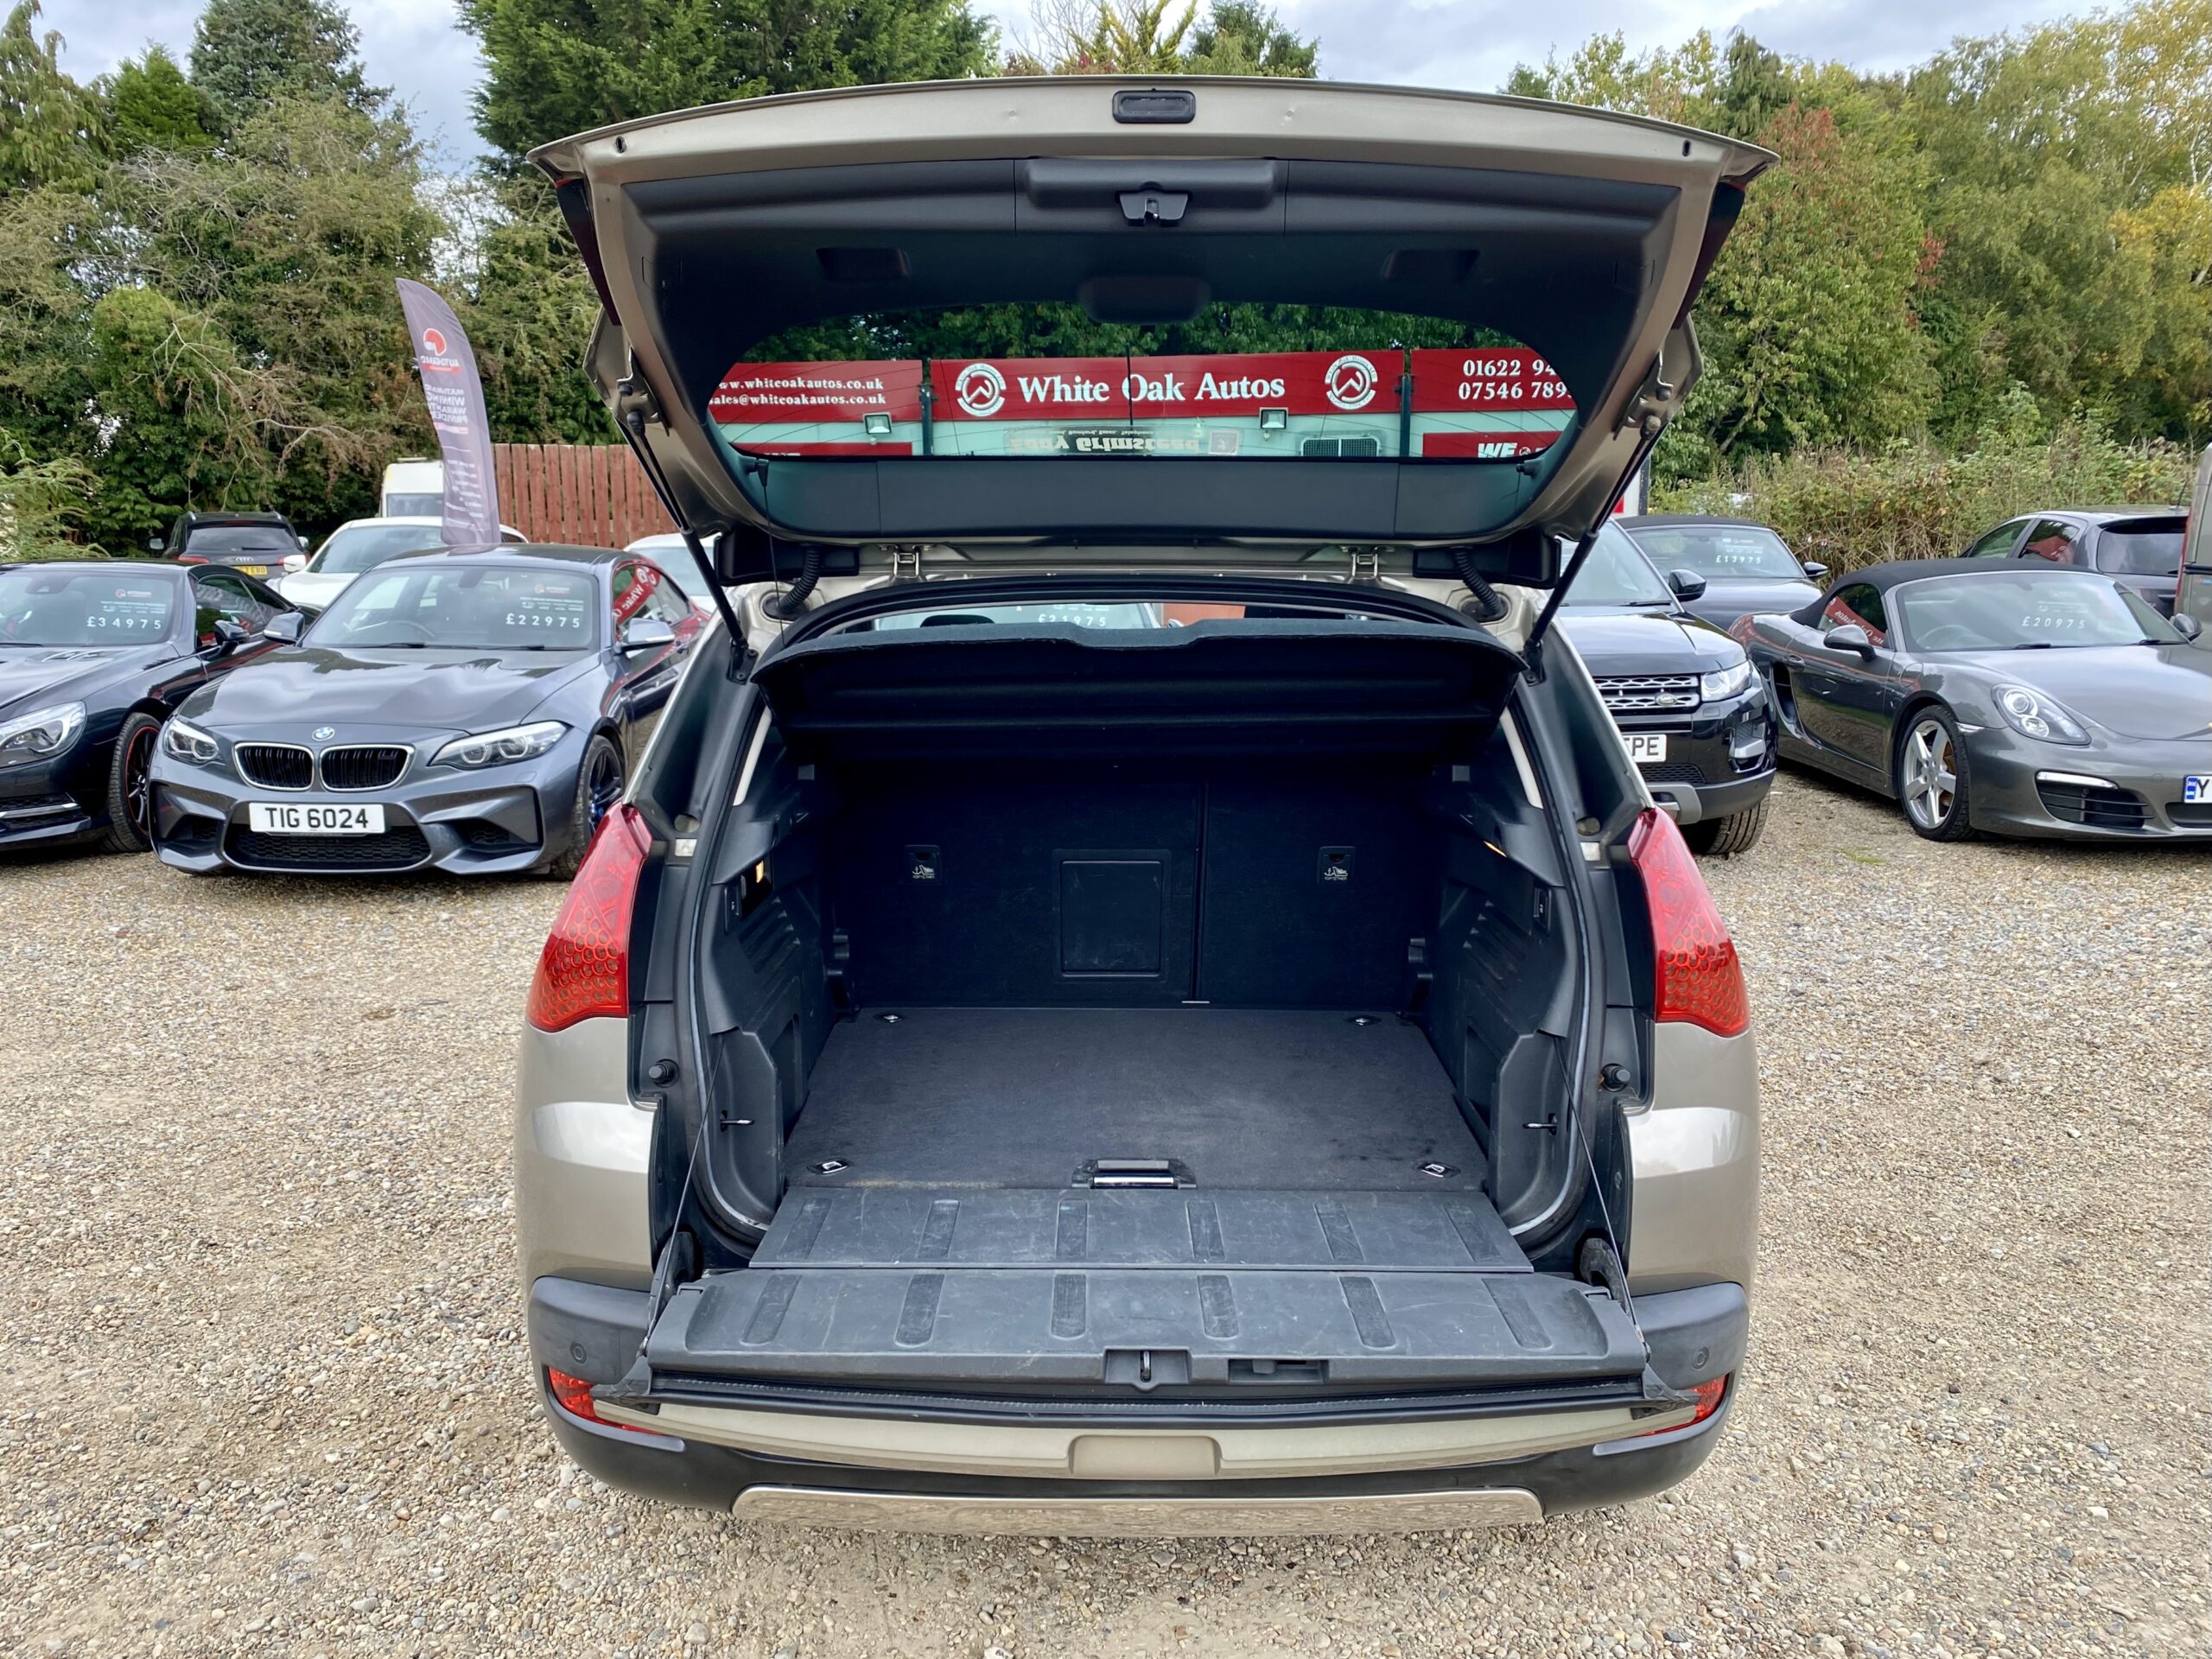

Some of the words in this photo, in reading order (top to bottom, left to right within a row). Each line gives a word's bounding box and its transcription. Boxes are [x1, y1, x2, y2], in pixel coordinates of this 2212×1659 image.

[1463, 359, 1521, 376] 01622
[1017, 374, 1110, 403] White
[1122, 372, 1186, 402] Oak
[1194, 372, 1286, 400] Autos
[1459, 382, 1522, 400] 07546
[1531, 382, 1572, 398] 789
[86, 615, 161, 630] £34975
[505, 613, 580, 629] £22975
[2022, 615, 2086, 630] £20975
[1624, 736, 1659, 756] PE
[264, 807, 300, 828] TIG
[308, 808, 369, 829] 6024
